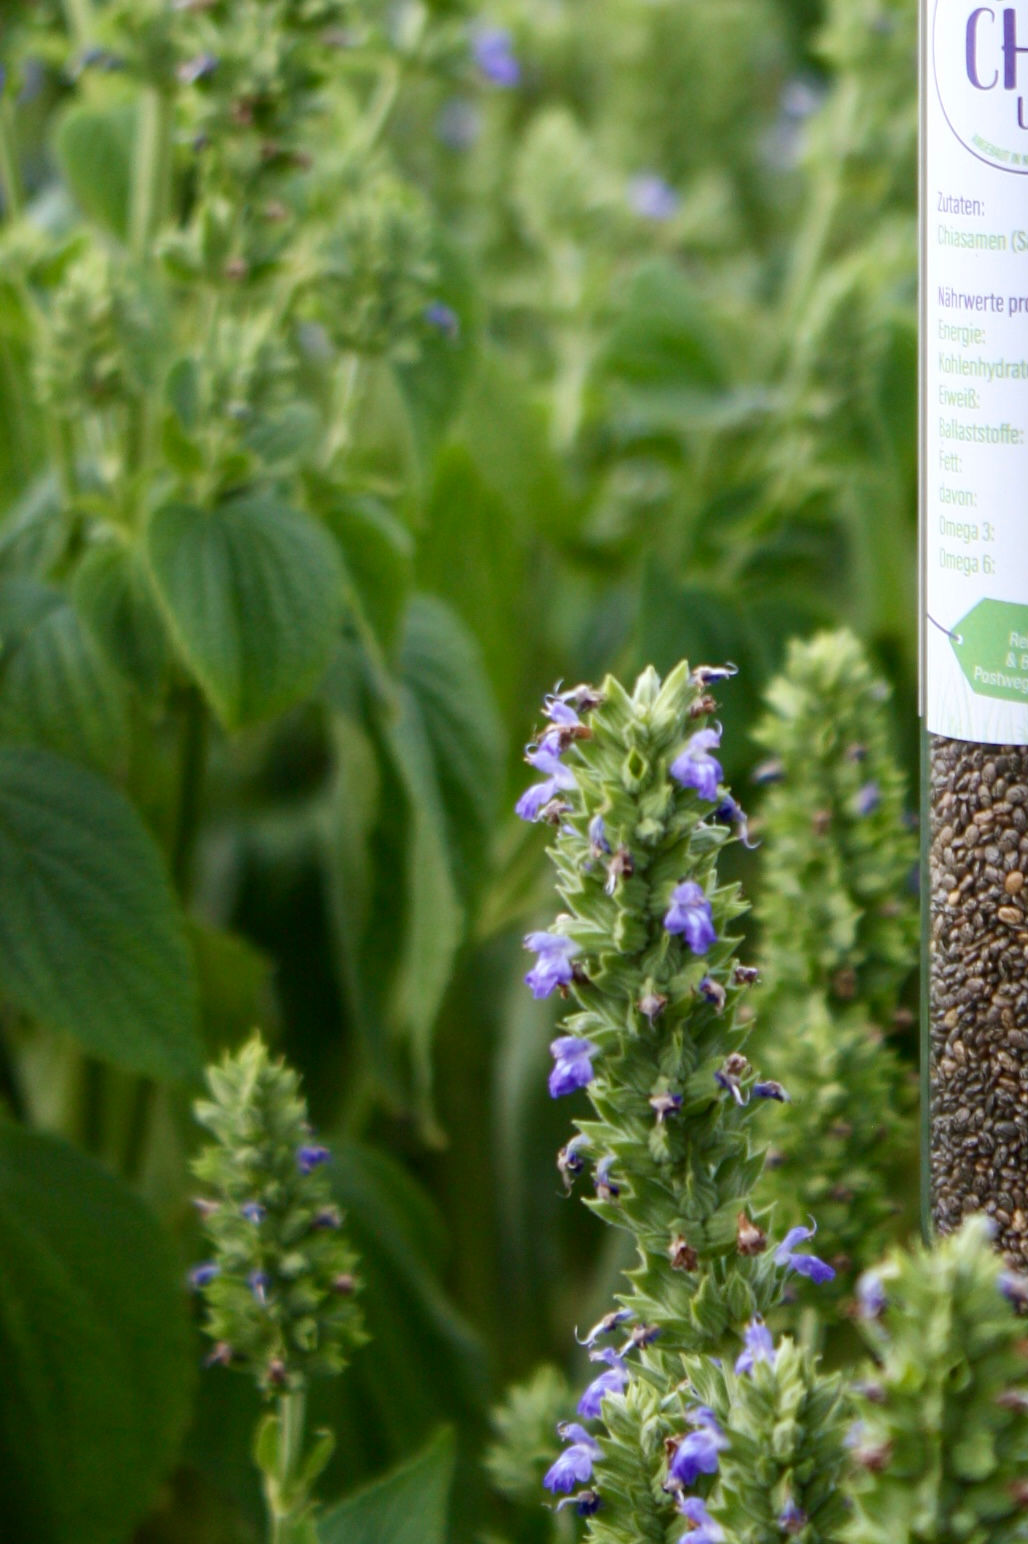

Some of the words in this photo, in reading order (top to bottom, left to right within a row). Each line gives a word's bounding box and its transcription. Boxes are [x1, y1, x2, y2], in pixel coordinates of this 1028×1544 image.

[937, 191, 985, 217] Zutaten:
[937, 224, 1007, 251] Chiasamen
[937, 286, 1004, 313] Nährwerte
[937, 319, 986, 348] Energie:
[938, 384, 980, 410] Eiweiß:
[938, 417, 1024, 445] Ballaststoffe:
[938, 450, 963, 473] Fett:
[938, 482, 977, 507] davon:
[938, 514, 979, 544] Omega
[982, 521, 995, 542] 3:
[938, 547, 979, 577] Omega
[983, 554, 996, 575] 6:
[1006, 651, 1017, 669] &
